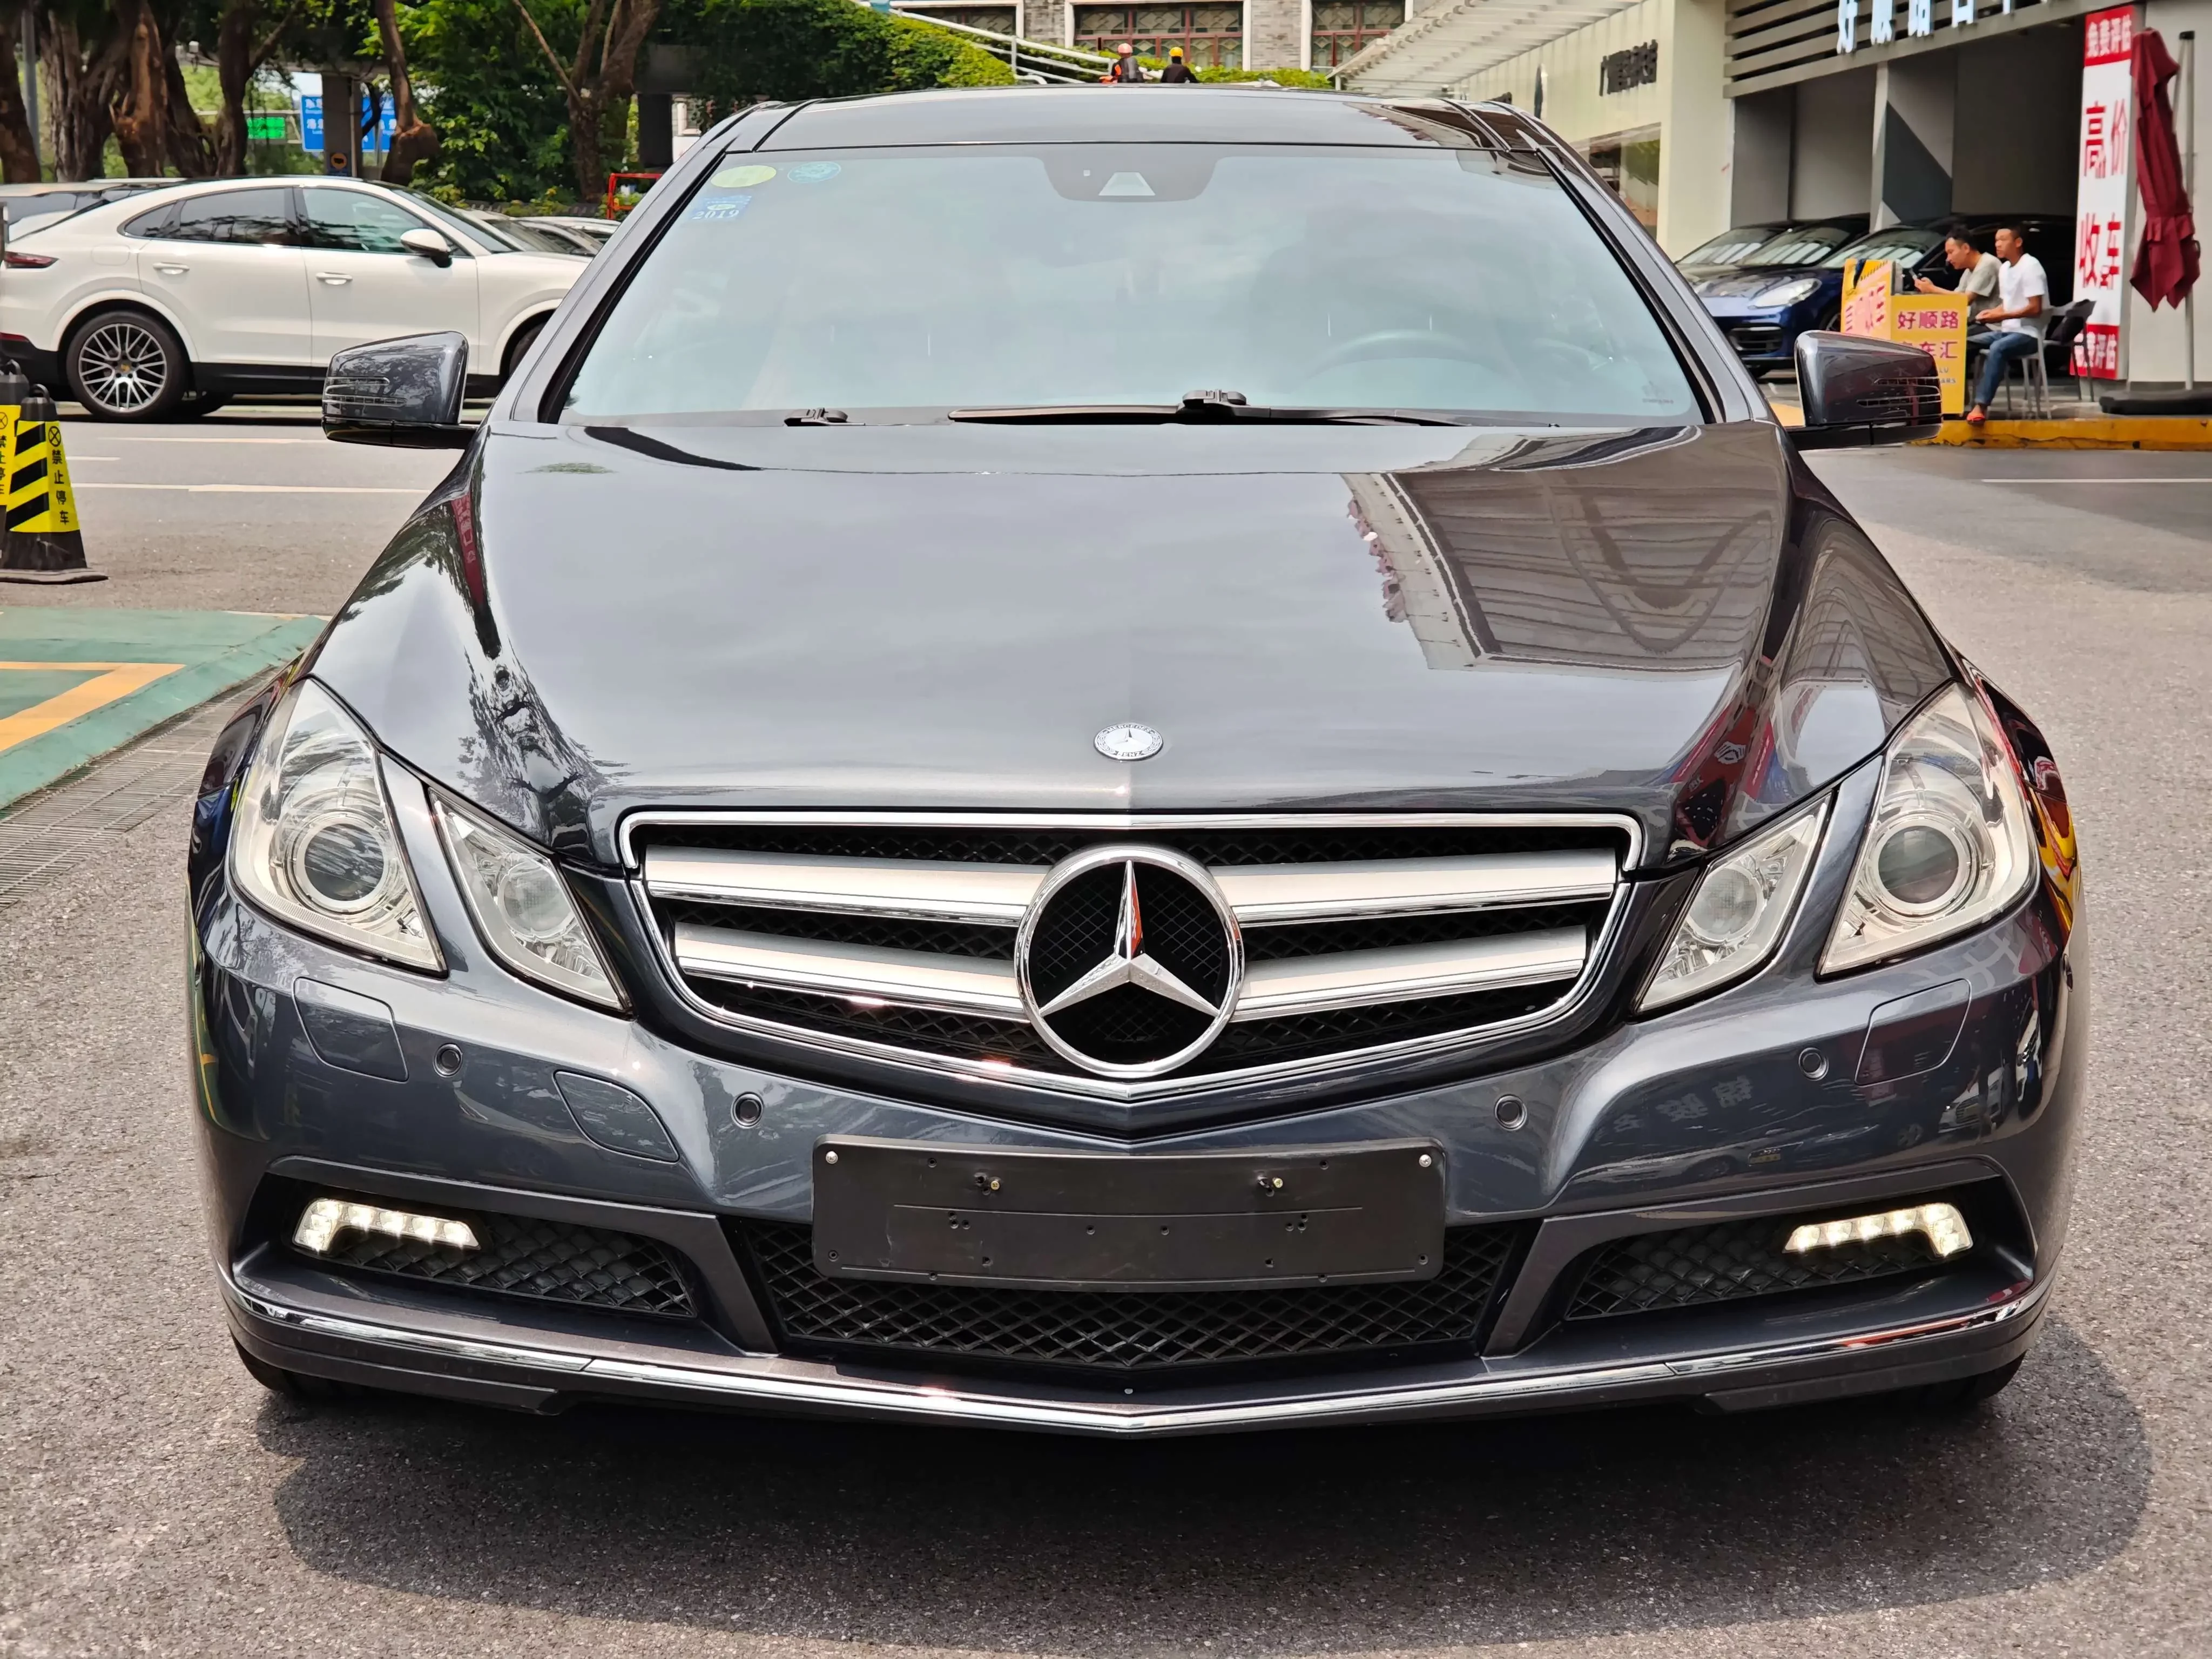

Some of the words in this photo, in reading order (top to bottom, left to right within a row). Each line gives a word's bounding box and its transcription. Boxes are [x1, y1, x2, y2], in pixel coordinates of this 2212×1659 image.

[2083, 99, 2127, 179] 高价
[2079, 212, 2121, 289] 收车
[1898, 311, 1959, 329] 好顺路
[1899, 341, 1958, 359] 车汇
[51, 449, 69, 525] 禁止停车
